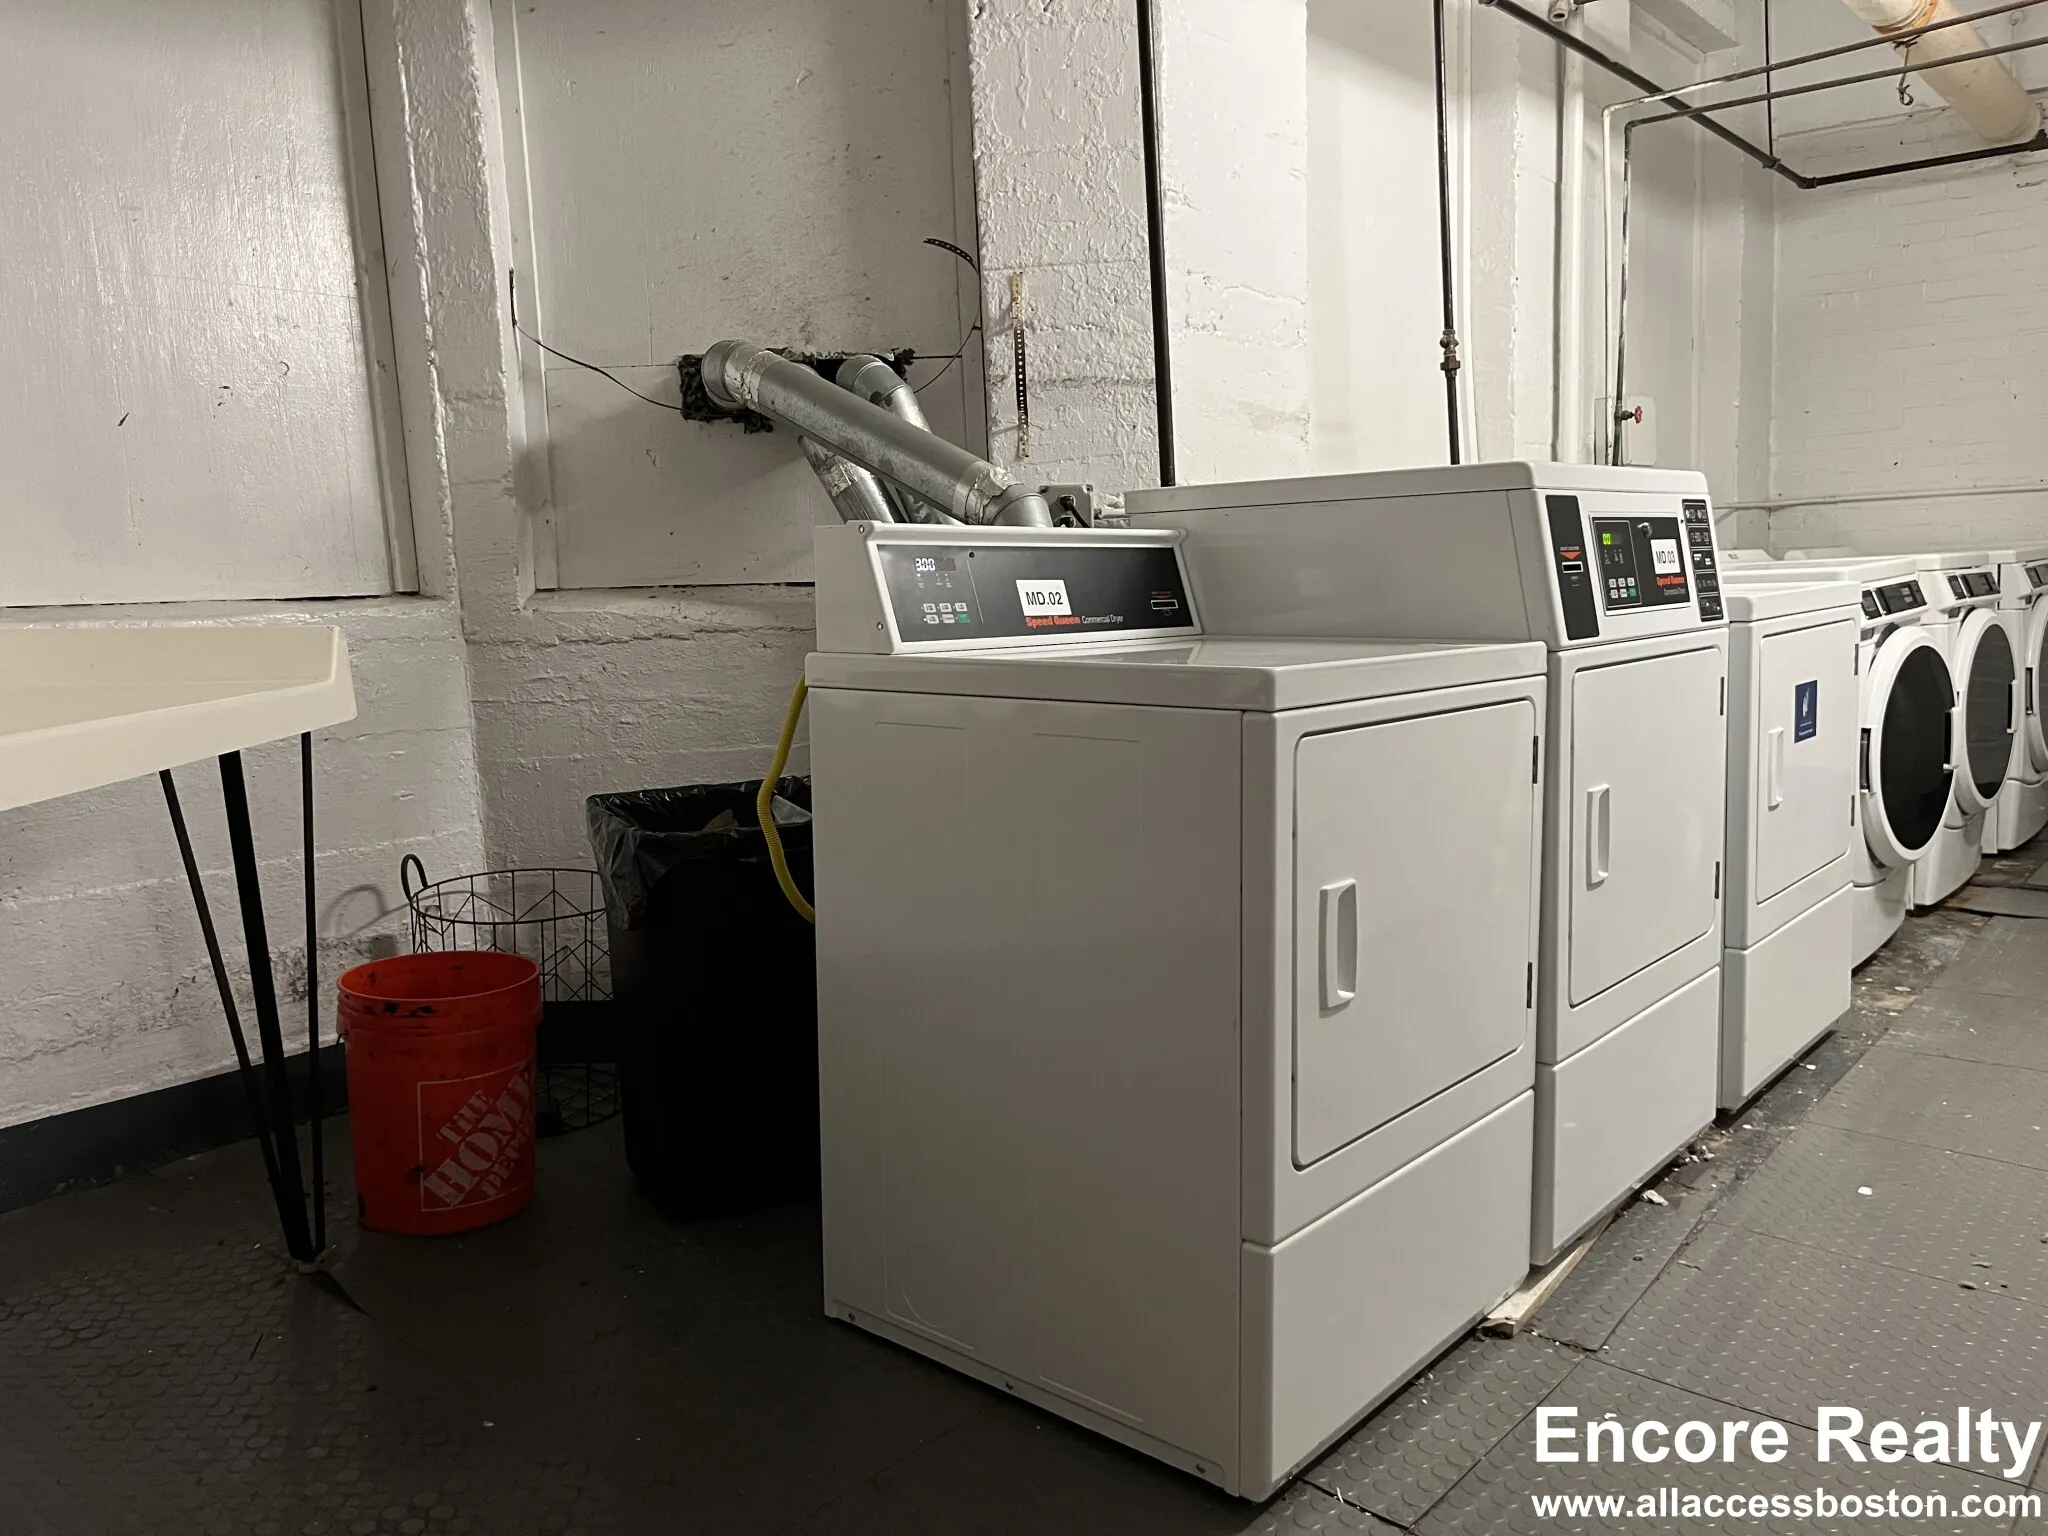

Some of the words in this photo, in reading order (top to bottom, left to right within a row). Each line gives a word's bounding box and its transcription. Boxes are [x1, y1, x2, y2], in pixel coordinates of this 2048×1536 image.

[1655, 550, 1676, 564] MD.03
[1025, 591, 1064, 606] MD.02
[1025, 616, 1054, 628] Speed
[1053, 615, 1081, 625] Queen
[1081, 614, 1111, 625] Commercial
[436, 1089, 493, 1144] THE
